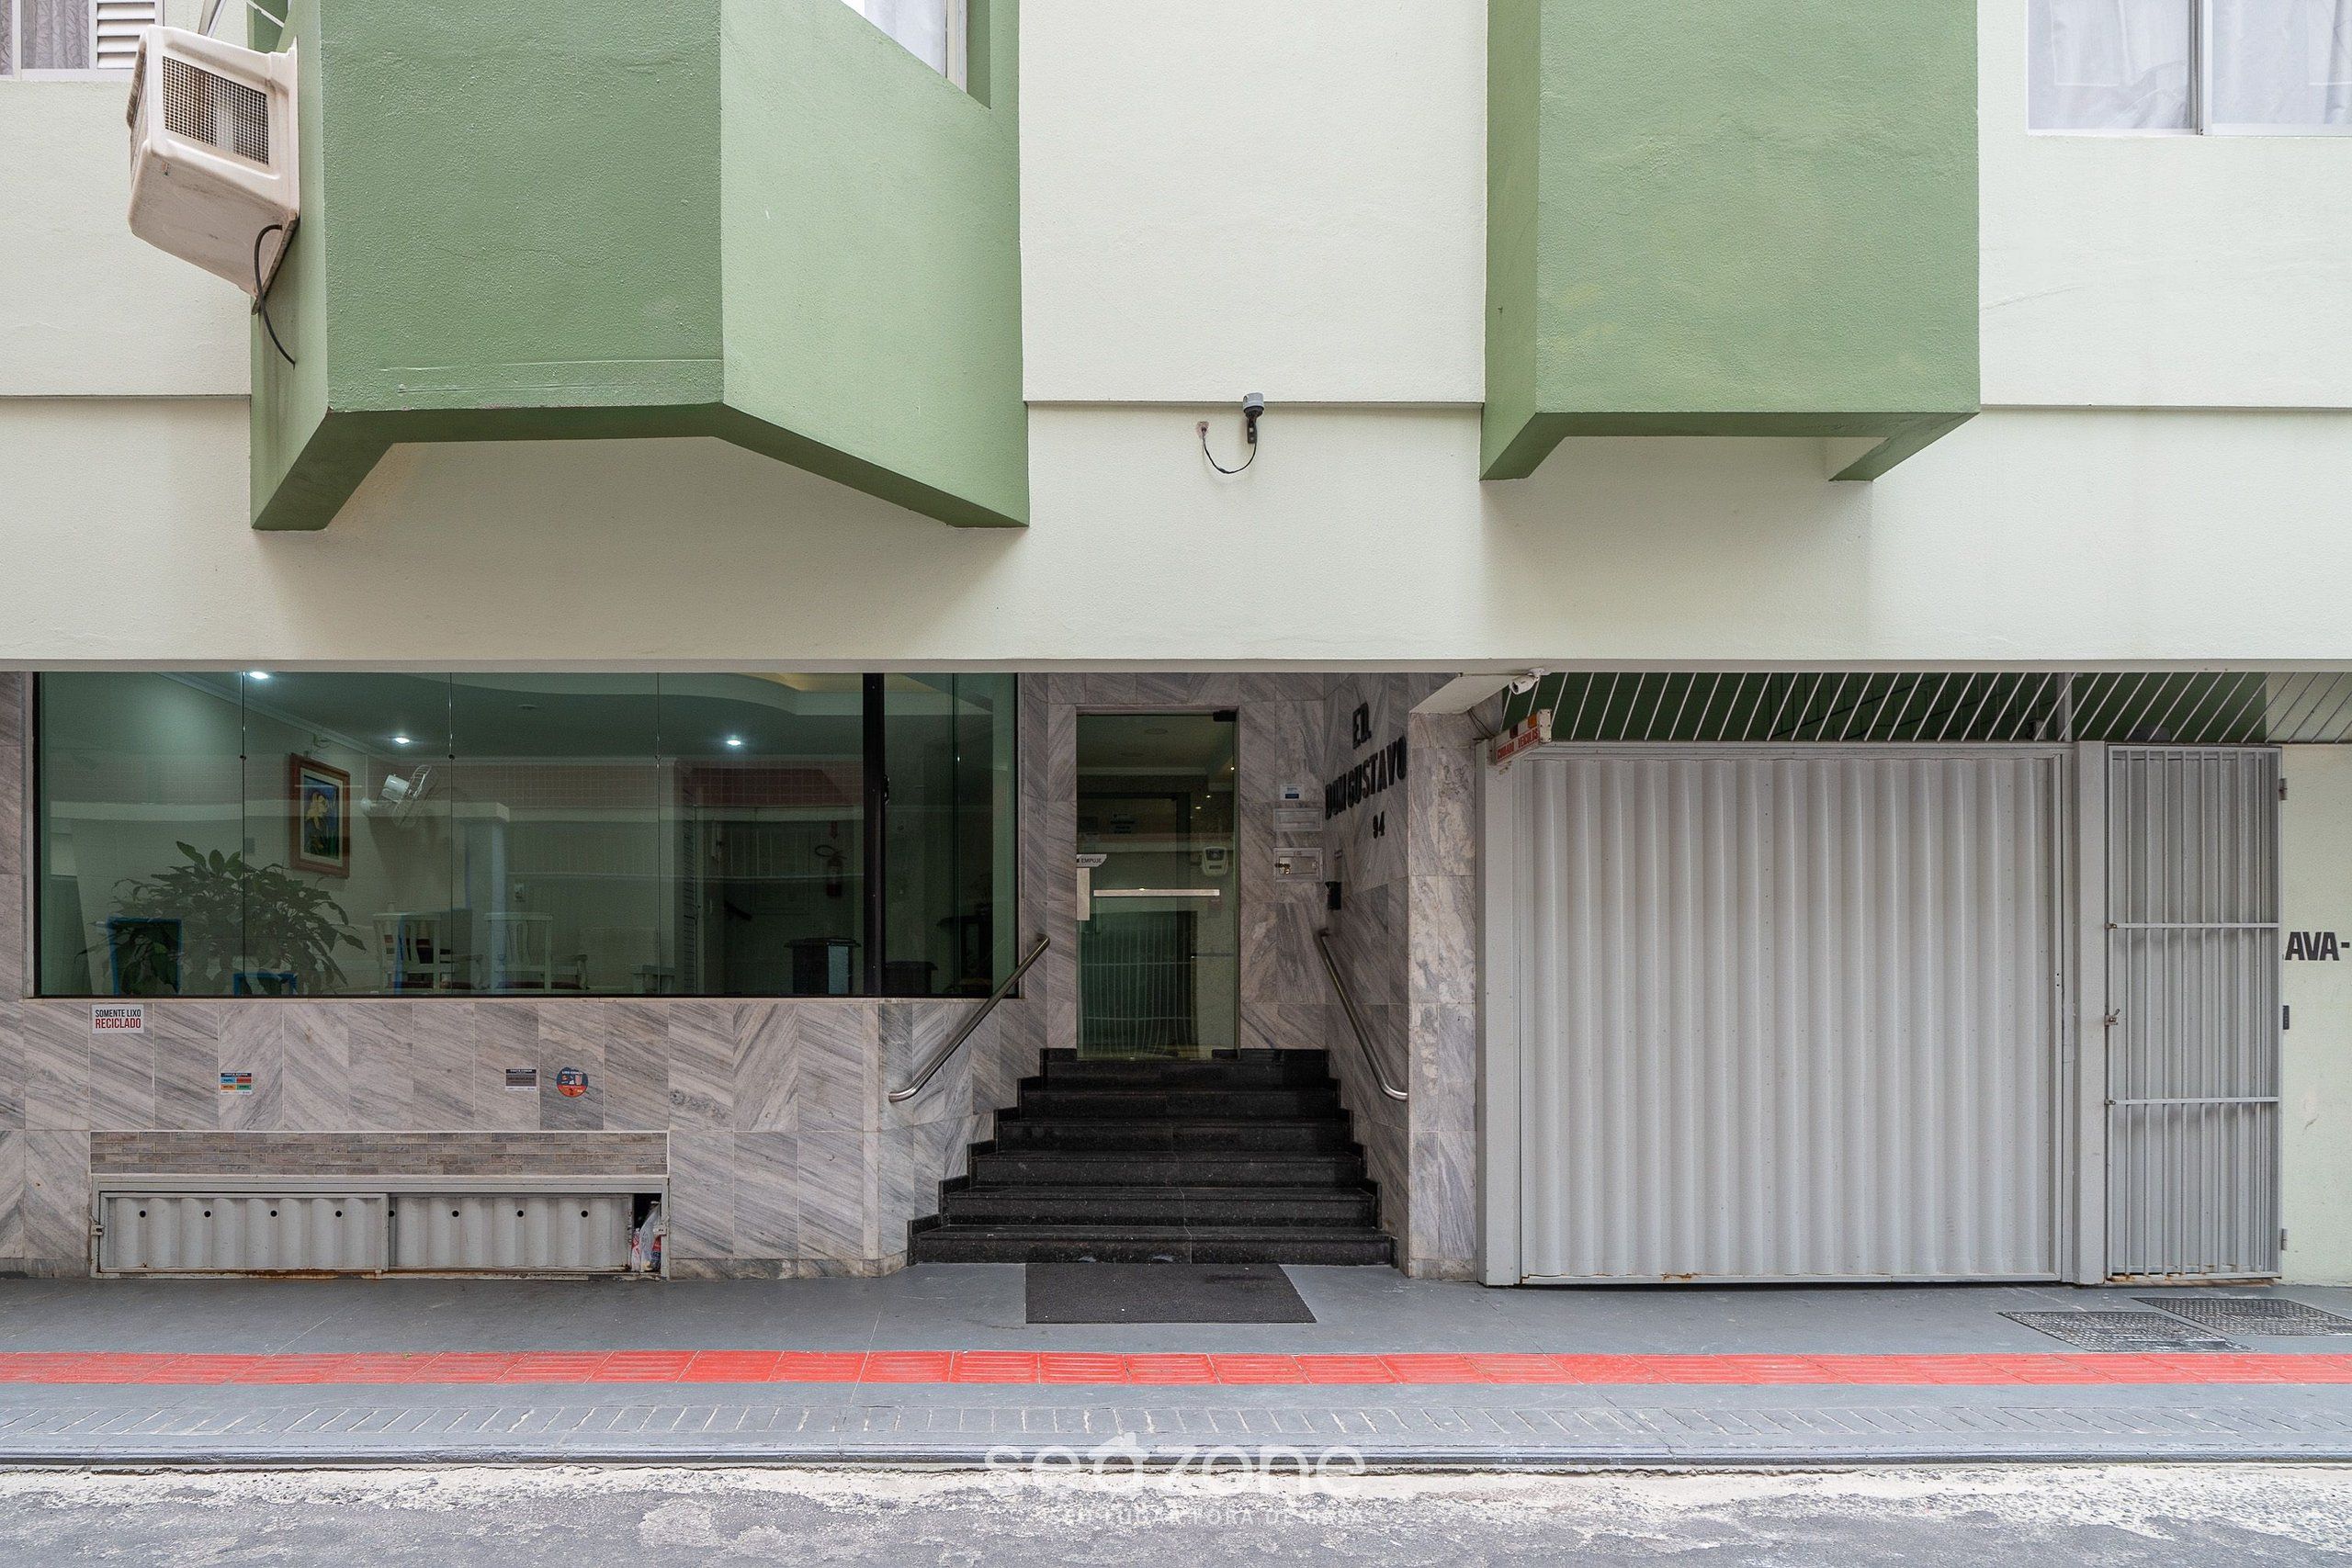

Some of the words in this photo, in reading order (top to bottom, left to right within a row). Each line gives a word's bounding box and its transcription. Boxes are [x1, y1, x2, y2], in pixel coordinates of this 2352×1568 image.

[1373, 810, 1385, 839] 94
[2282, 931, 2350, 961] AVA-
[95, 1010, 126, 1018] SOMENTE
[95, 1018, 141, 1029] RECICLADO
